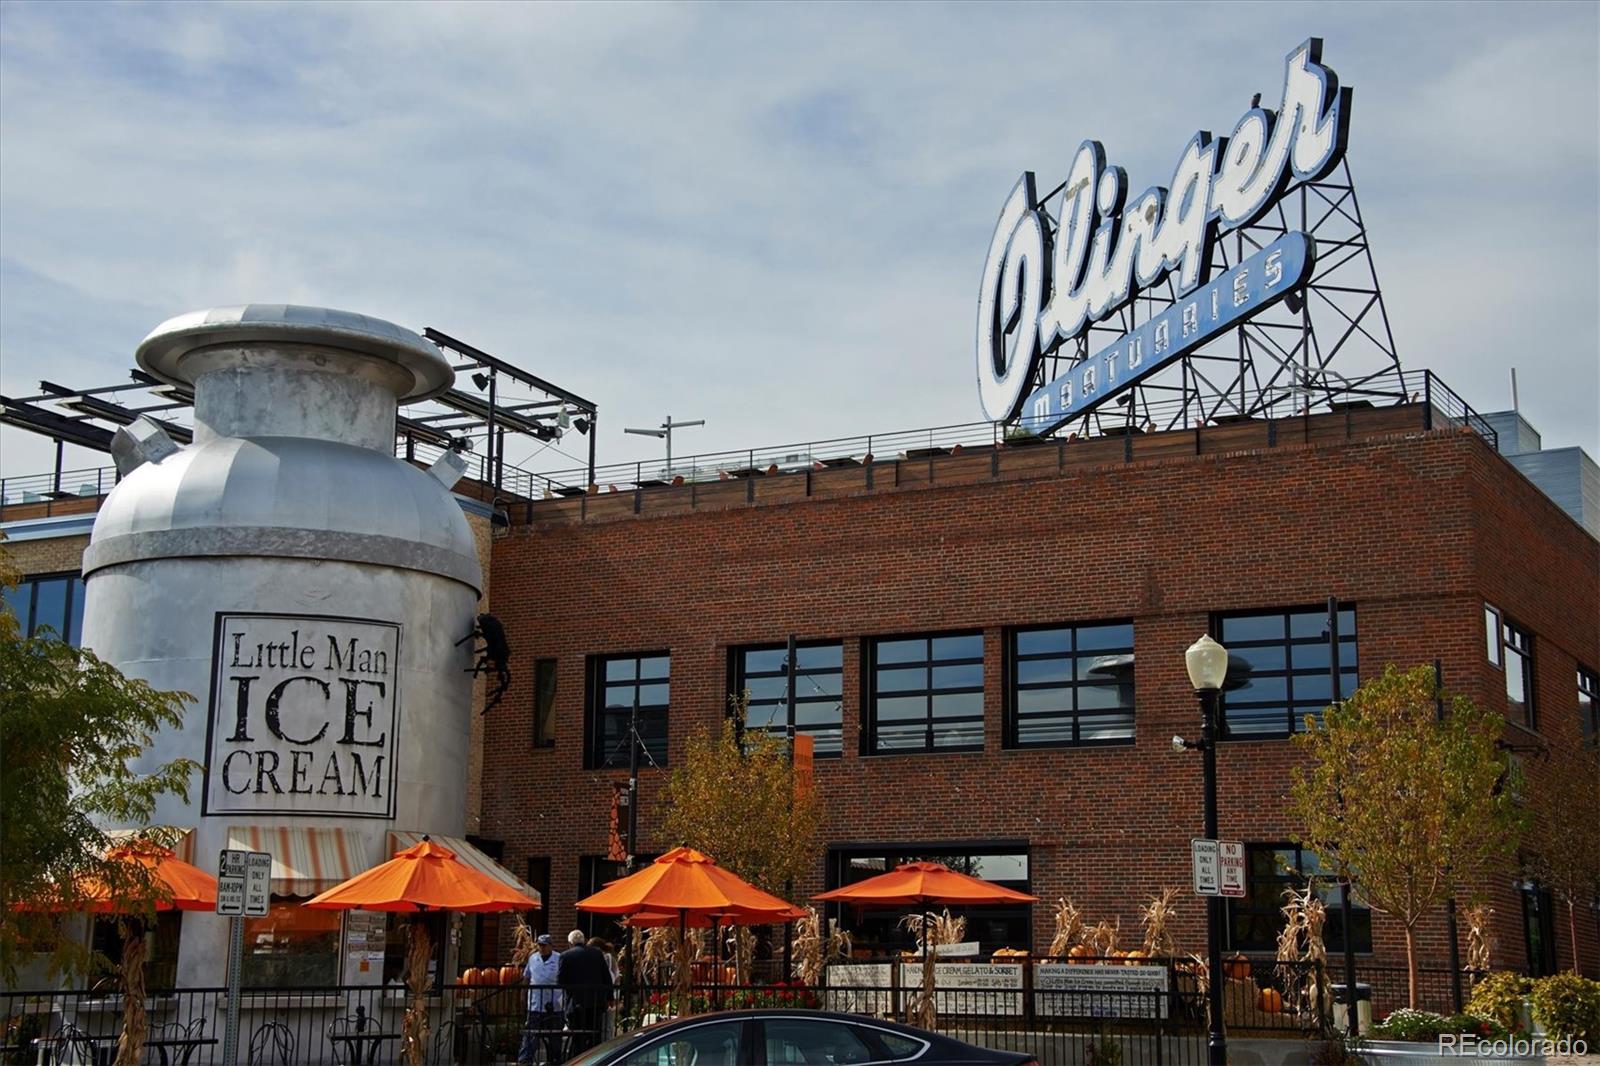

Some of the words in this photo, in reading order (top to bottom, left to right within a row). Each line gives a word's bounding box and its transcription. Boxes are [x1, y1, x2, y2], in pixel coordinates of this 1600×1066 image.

[976, 37, 1353, 423] Olinger
[1031, 247, 1283, 424] MORTUARIES
[230, 630, 315, 669] Little
[324, 634, 389, 674] Man
[225, 675, 386, 748] ICE
[222, 750, 385, 798] CREAM
[1195, 844, 1216, 853] LOADING
[1226, 844, 1236, 855] NO
[231, 853, 240, 863] HR
[248, 858, 270, 867] LOADING
[1199, 856, 1212, 864] ONLY
[1220, 857, 1243, 868] PARKING
[220, 855, 226, 872] 2
[226, 864, 245, 874] PARKING
[1202, 866, 1211, 874] ALL
[252, 871, 264, 879] ONLY
[1200, 876, 1214, 884] TIMES
[1226, 875, 1238, 883] TIME
[253, 884, 262, 892] ALL
[250, 895, 264, 903] TIMES
[962, 966, 988, 975] GELATO
[989, 966, 994, 975] &
[994, 966, 1018, 976] SORBET
